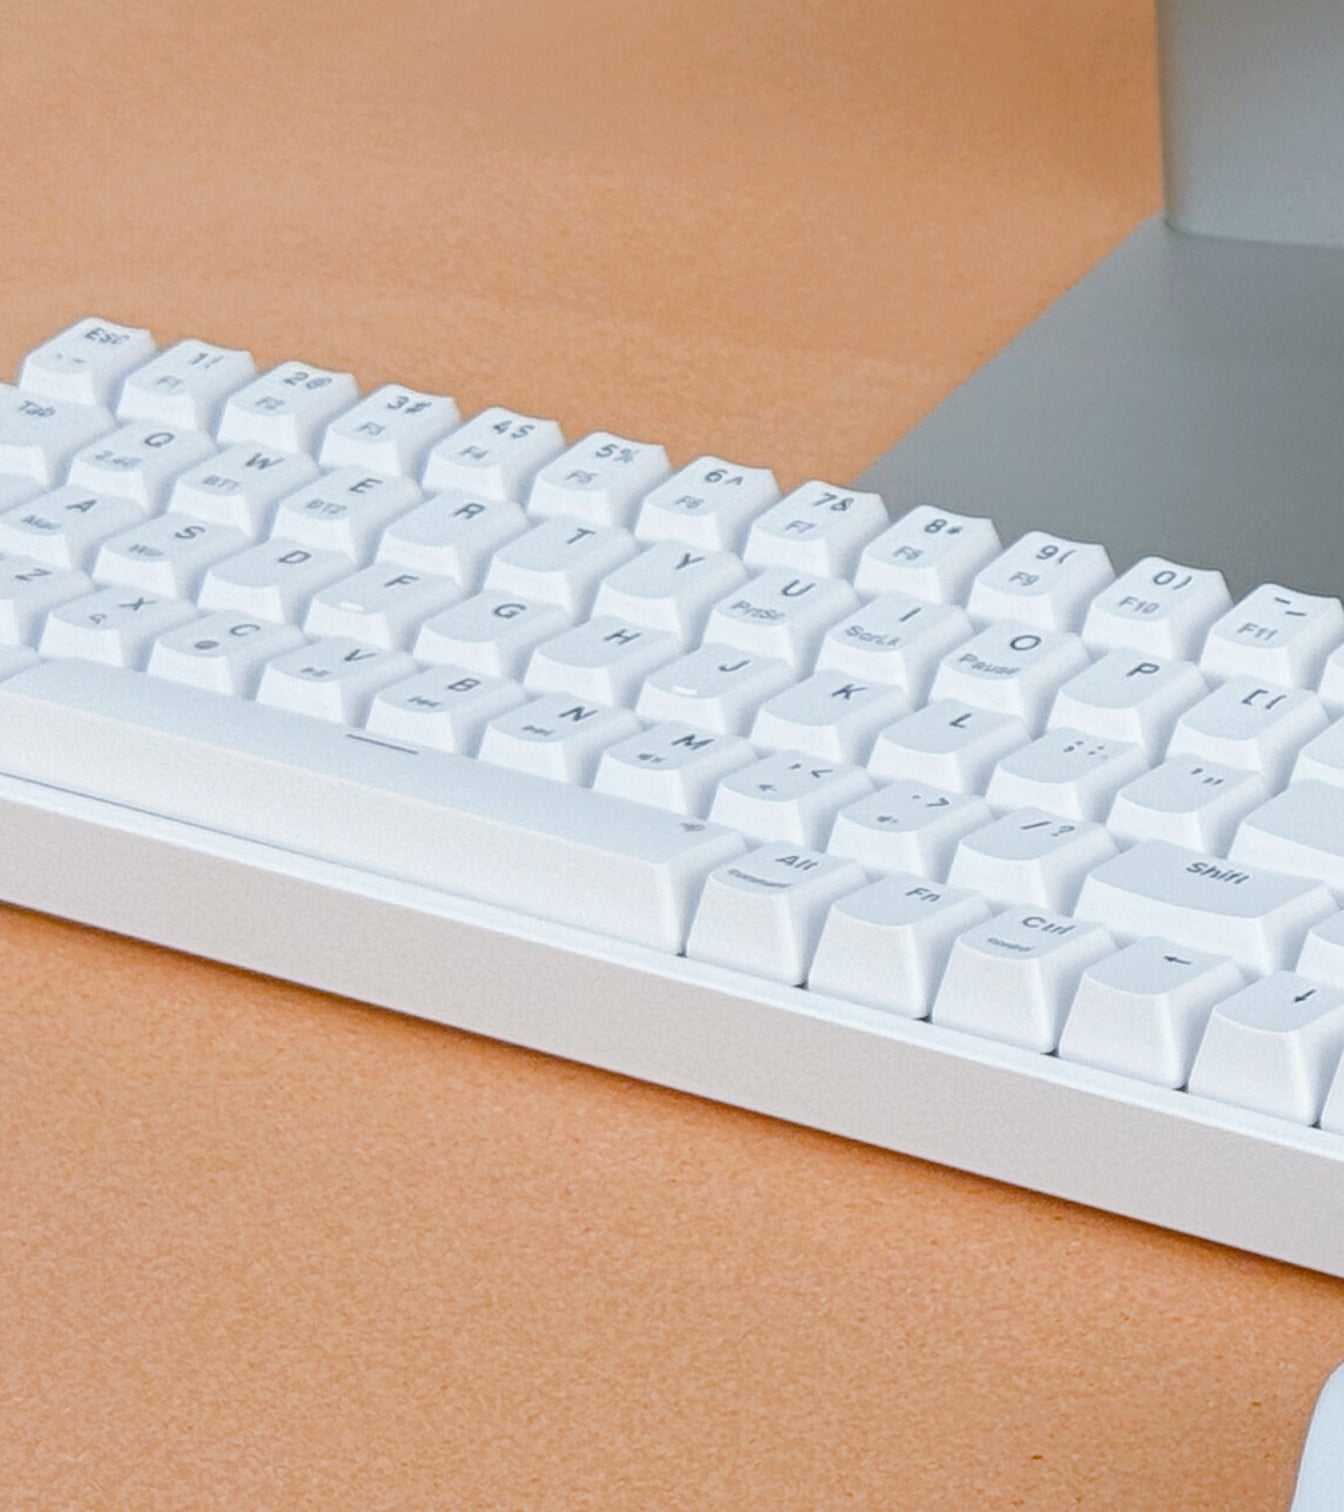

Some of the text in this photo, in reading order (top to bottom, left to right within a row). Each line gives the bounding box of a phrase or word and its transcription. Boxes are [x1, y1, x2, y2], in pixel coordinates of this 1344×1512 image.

[245, 452, 286, 471] W
[349, 477, 383, 494] E
[65, 499, 97, 513] A
[453, 502, 486, 520] R
[174, 525, 206, 540] S
[567, 527, 596, 545] T
[277, 550, 312, 565] D
[676, 553, 705, 570] Y
[383, 574, 420, 588] F
[781, 579, 817, 598] U
[492, 603, 526, 620] G
[229, 623, 261, 637] C
[604, 629, 642, 646] H
[343, 648, 378, 662] V
[719, 660, 752, 673] J
[1126, 663, 1160, 678] P
[448, 678, 481, 692] B
[832, 684, 868, 700] K
[558, 706, 601, 722] N
[949, 713, 973, 729] L
[671, 734, 716, 750] M
[1185, 861, 1252, 885] Shift
[904, 887, 942, 903] Fn
